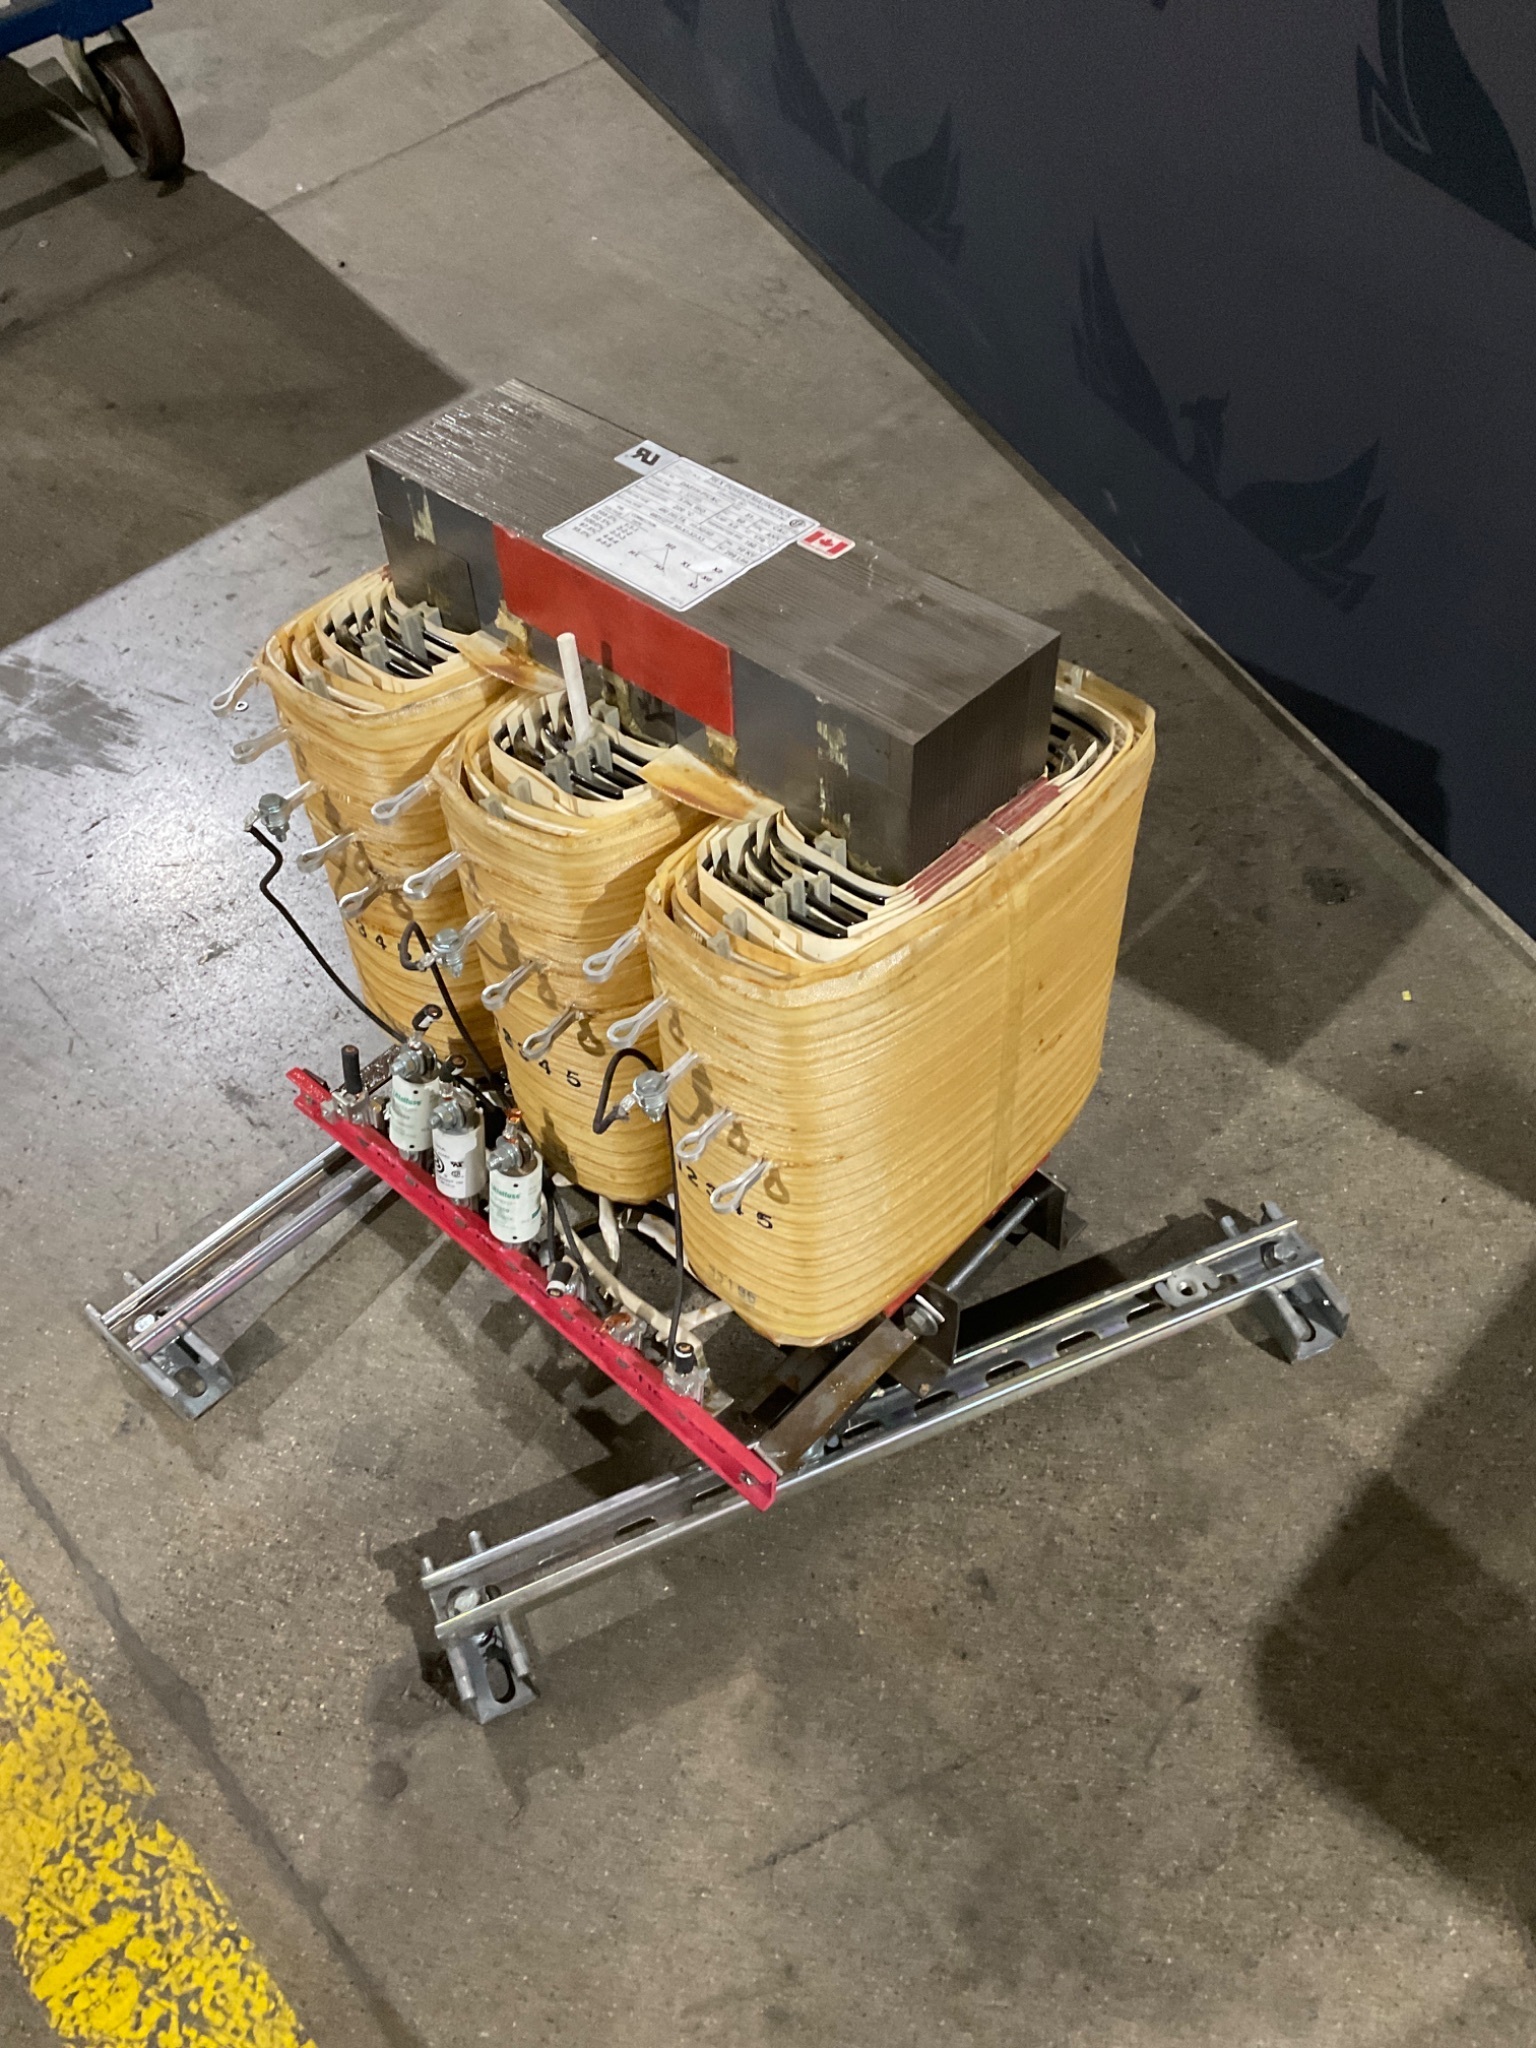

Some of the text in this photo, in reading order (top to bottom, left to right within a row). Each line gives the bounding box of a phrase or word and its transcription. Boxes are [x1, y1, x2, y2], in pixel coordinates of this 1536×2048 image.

[538, 1060, 551, 1075] 4
[566, 1070, 581, 1088] 5
[686, 1166, 699, 1188] 2
[756, 1212, 773, 1229] 5
